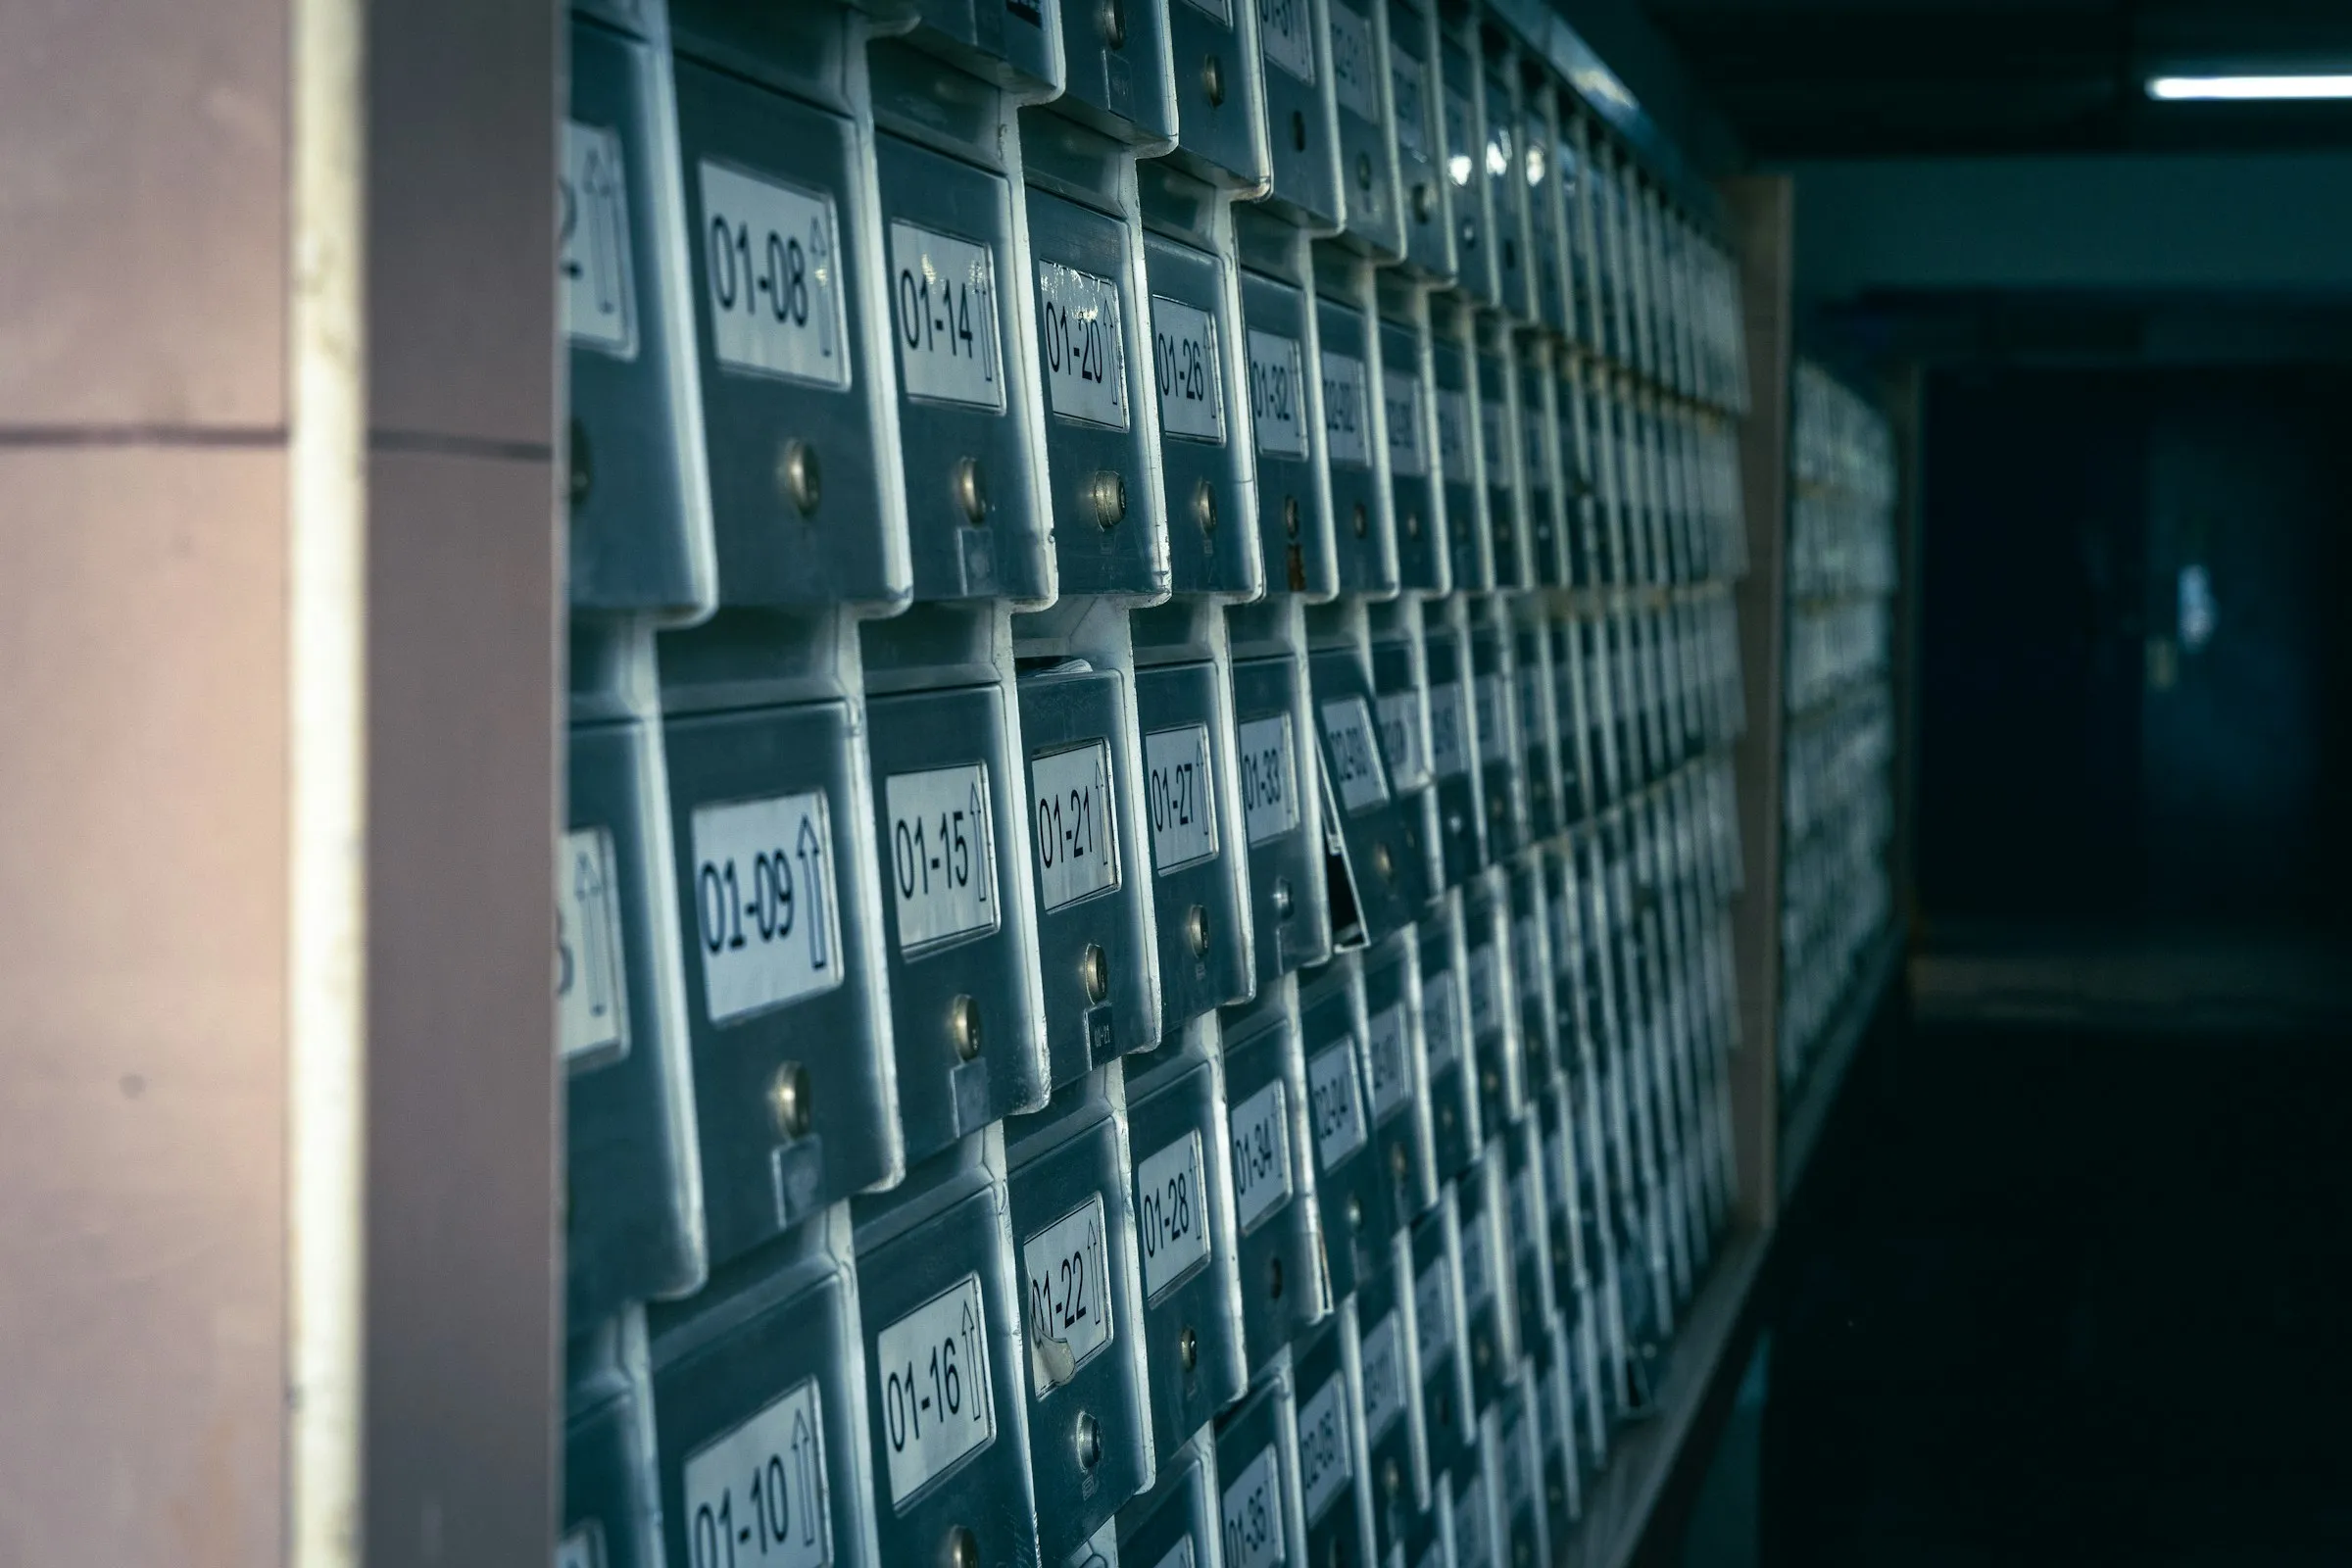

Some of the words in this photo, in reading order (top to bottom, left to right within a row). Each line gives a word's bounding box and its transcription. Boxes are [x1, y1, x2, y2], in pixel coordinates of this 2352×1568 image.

[710, 214, 809, 328] 01-08
[899, 270, 974, 360] 01-14
[1045, 301, 1103, 383] 01-20
[1157, 332, 1204, 402] 01-26
[1251, 362, 1291, 421] 01-32
[1151, 763, 1194, 833] 01-27
[1244, 754, 1282, 812] 01-33
[896, 810, 969, 901] 01-15
[1039, 789, 1095, 870] 01-21
[697, 851, 795, 956] 01-09
[1235, 1116, 1273, 1197] 01-34
[1143, 1172, 1190, 1259] 01-28
[887, 1336, 961, 1453] 01-16
[694, 1453, 791, 1568] 01-10
[1228, 1486, 1266, 1568] 01-35
